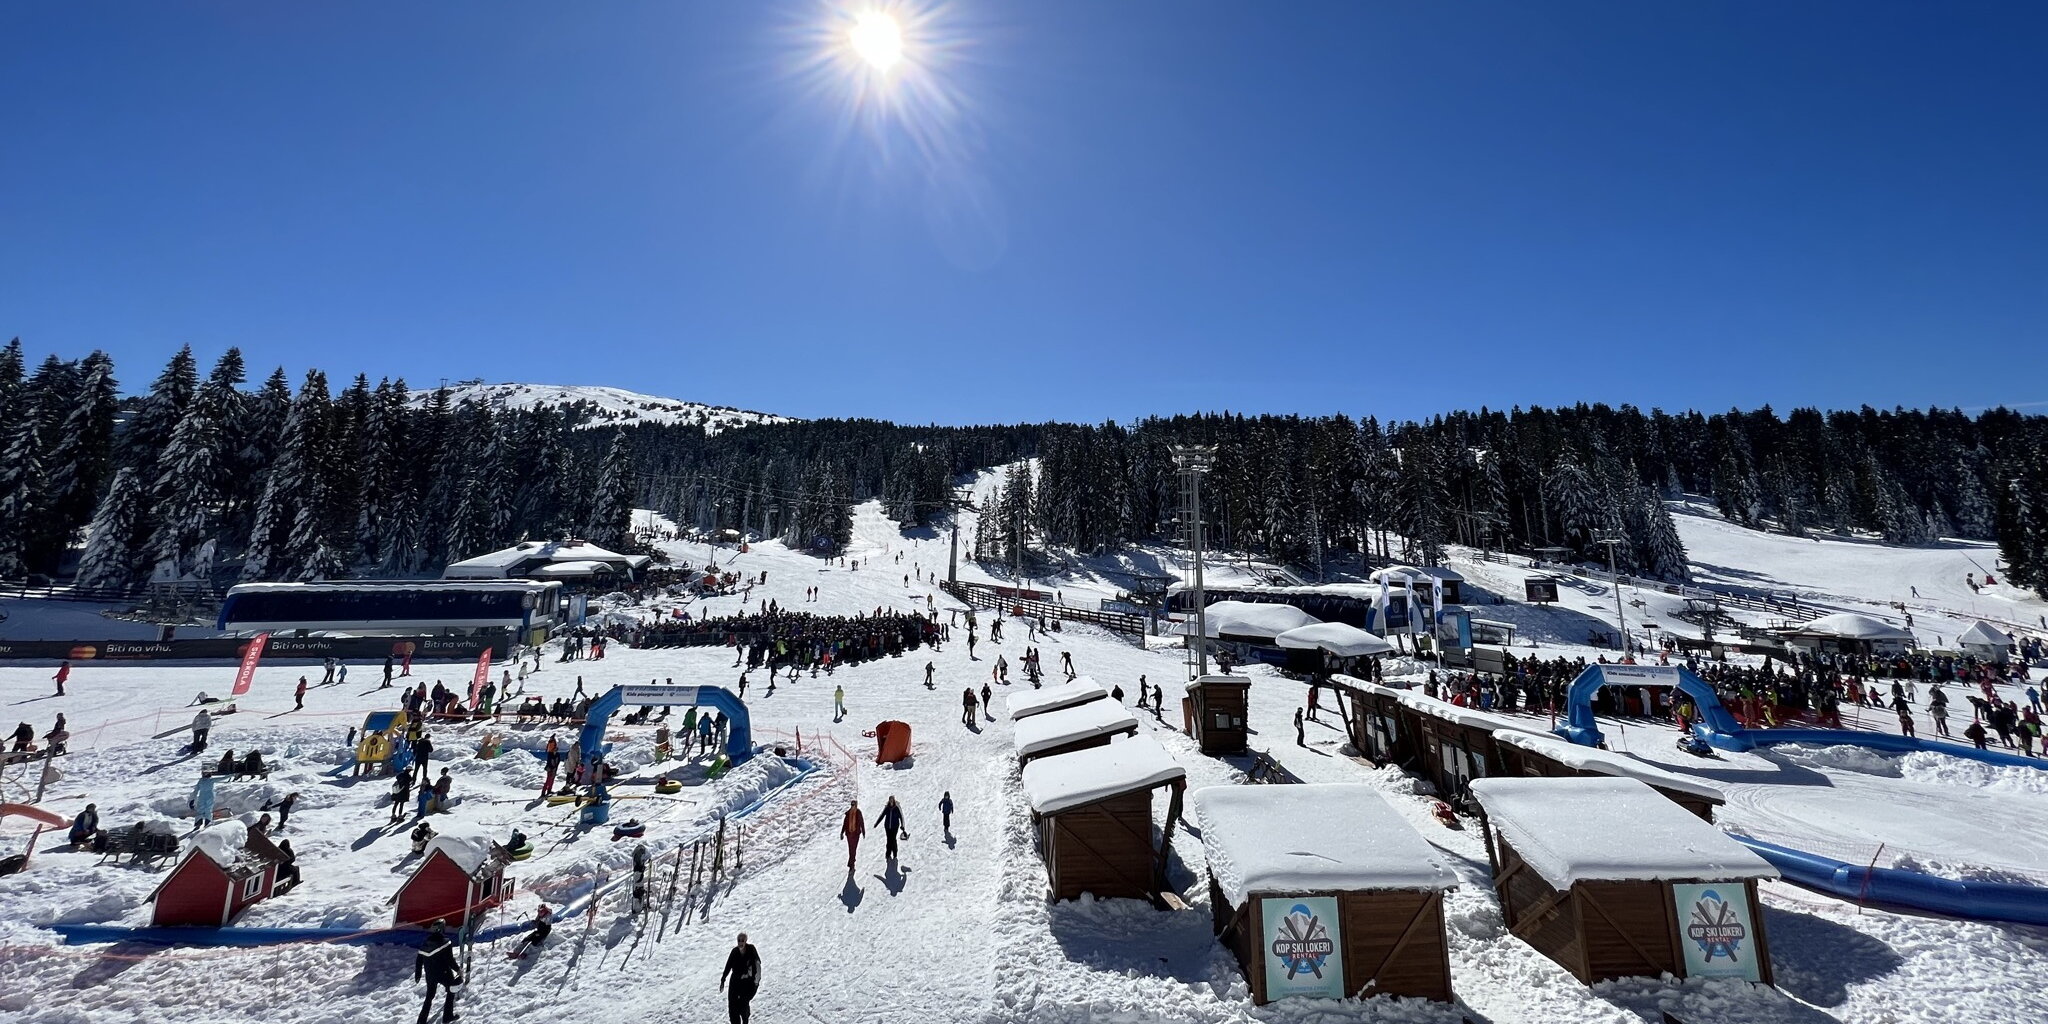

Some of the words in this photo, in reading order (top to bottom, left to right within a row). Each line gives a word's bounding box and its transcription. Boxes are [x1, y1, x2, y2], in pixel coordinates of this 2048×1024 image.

[106, 644, 126, 652] Biti
[145, 643, 172, 652] vrhu.
[271, 641, 290, 650] Biti
[307, 641, 332, 650] vrhu.
[424, 640, 440, 648] Biti
[456, 640, 480, 648] vrhu.
[249, 646, 259, 660] SKI
[240, 660, 255, 686] ŠKOLA
[1691, 927, 1705, 938] KOP
[1706, 926, 1718, 937] SKI
[1719, 926, 1743, 937] LOKERI
[1276, 943, 1290, 954] KOP
[1292, 942, 1304, 953] SKI
[1305, 942, 1331, 953] LOKERI
